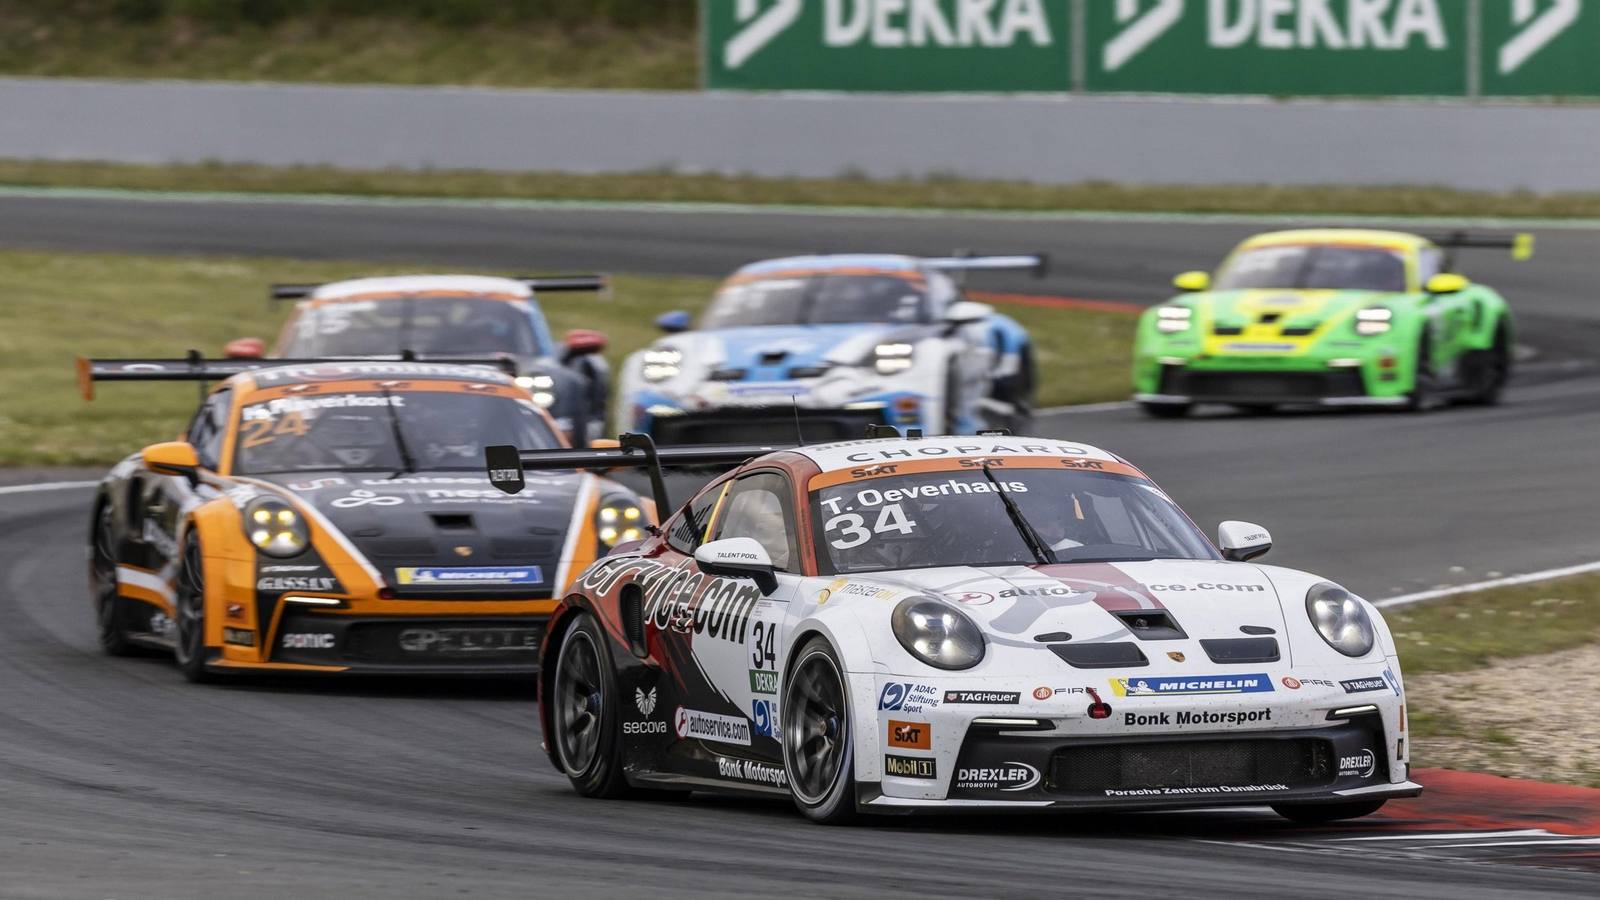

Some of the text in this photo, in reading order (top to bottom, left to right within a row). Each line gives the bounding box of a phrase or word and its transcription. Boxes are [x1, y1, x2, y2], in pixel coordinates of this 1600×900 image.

[823, 0, 1053, 47] DEKRA
[1207, 0, 1448, 49] DEKRA
[240, 410, 311, 448] 24
[847, 445, 1088, 462] CHOPARD
[820, 480, 1028, 515] T. Oeverhaus
[824, 503, 917, 550] 34
[577, 557, 760, 645] ervice.com
[753, 620, 776, 670] 34
[755, 673, 778, 692] DEKRA
[914, 684, 937, 695] ADAC
[1159, 679, 1258, 691] MICHELIN
[1300, 679, 1336, 688] FIRE
[903, 703, 922, 714] Sport
[908, 694, 940, 707] Stiftung
[1124, 707, 1271, 726] Bonk Motorsport
[623, 721, 667, 733] secova
[690, 714, 749, 741] autoservice.com
[719, 757, 743, 778] Bonk
[887, 757, 917, 775] Mobil
[1340, 755, 1371, 769] DREXLER
[958, 768, 1027, 781] DREXLER
[1105, 783, 1290, 796] Porsche Zentrum Osnabrück
